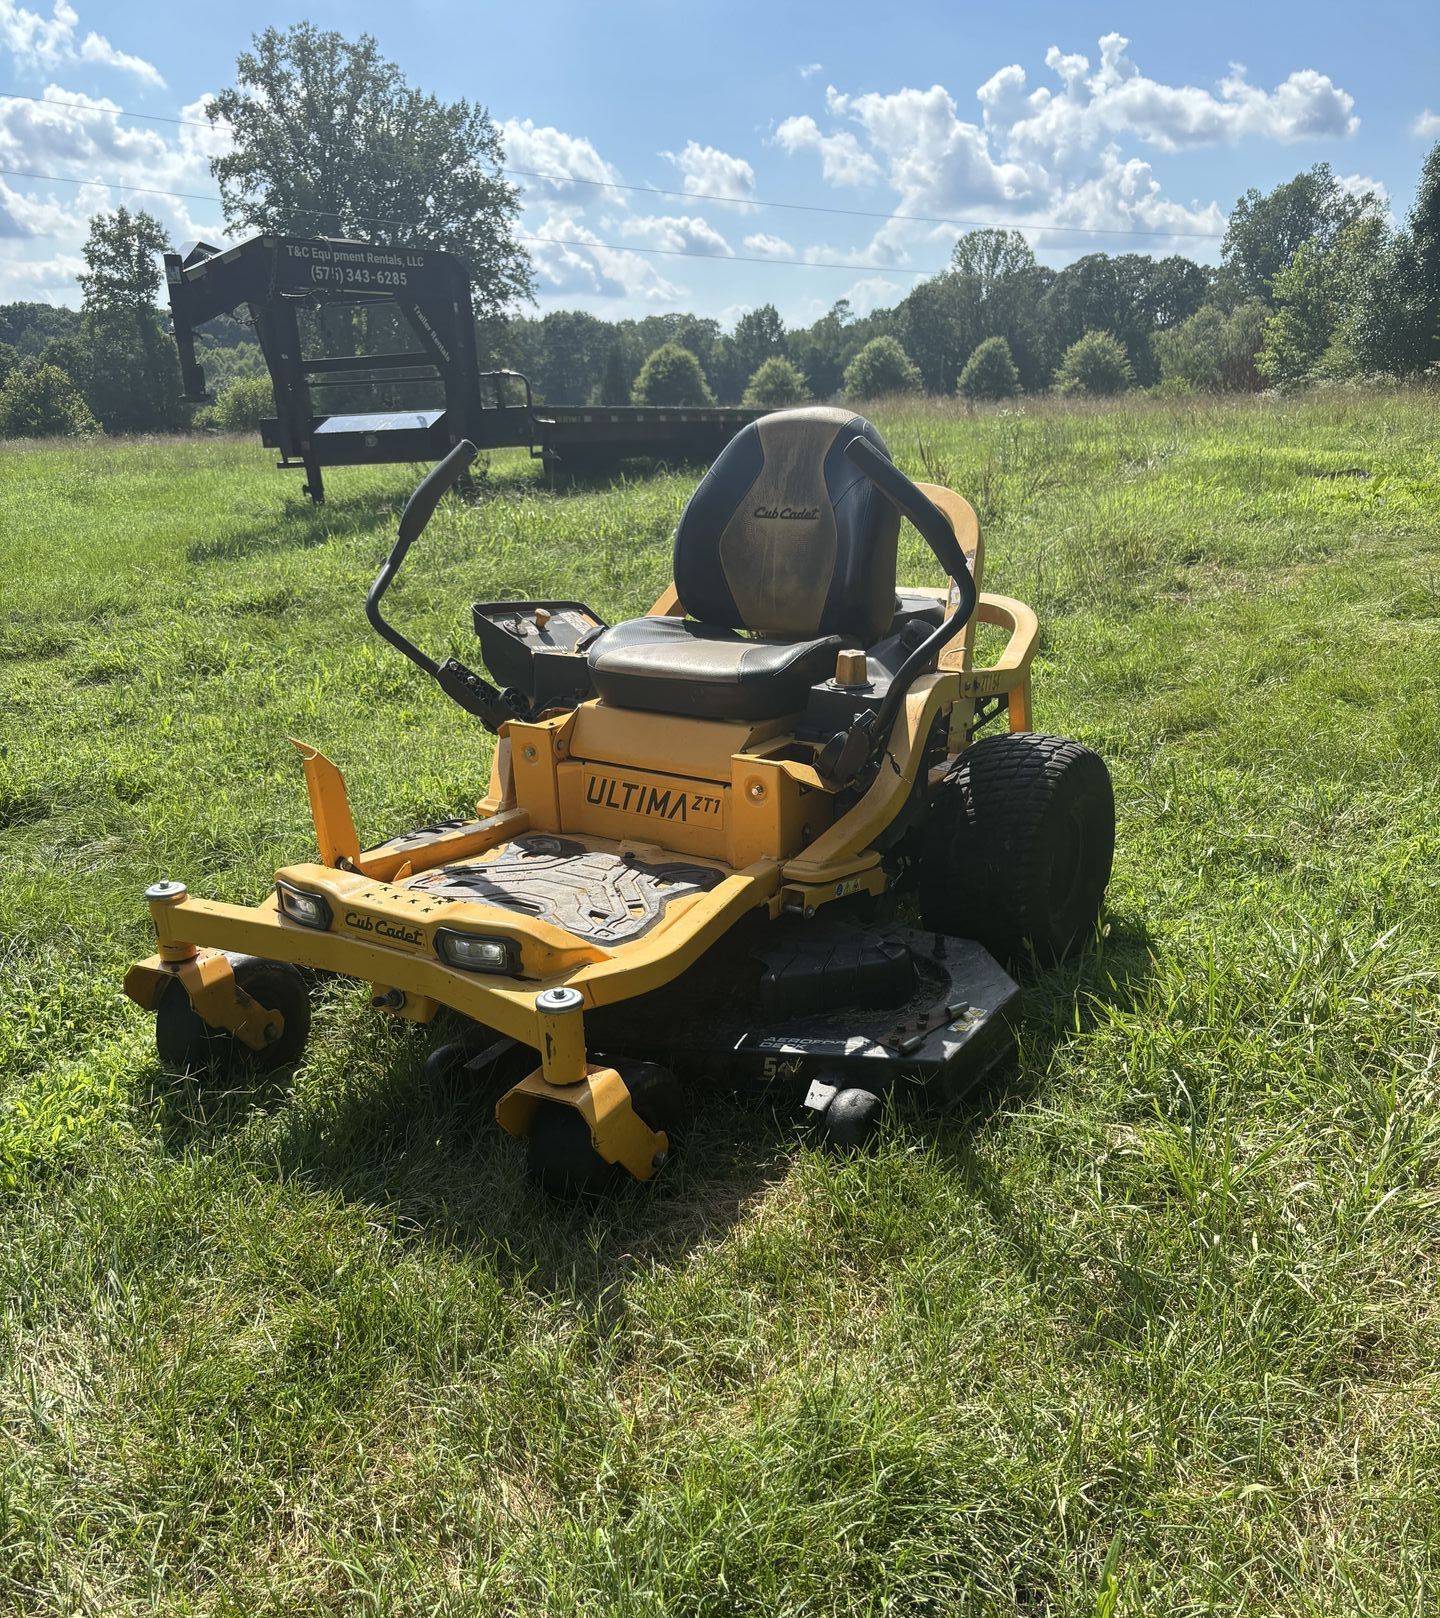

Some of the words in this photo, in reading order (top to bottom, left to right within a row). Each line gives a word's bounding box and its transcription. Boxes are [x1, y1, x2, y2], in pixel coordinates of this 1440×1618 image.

[286, 245, 309, 258] T&C
[311, 247, 364, 262] Equpment
[367, 253, 405, 268] Rentals,
[407, 256, 424, 267] LLC
[346, 268, 408, 285] 343-6285
[754, 506, 778, 519] Cub
[780, 507, 820, 520] Cadet
[586, 776, 687, 822] ULTIMA
[691, 795, 721, 814] ZT1
[345, 912, 374, 931] Cub
[375, 921, 425, 944] Cadet
